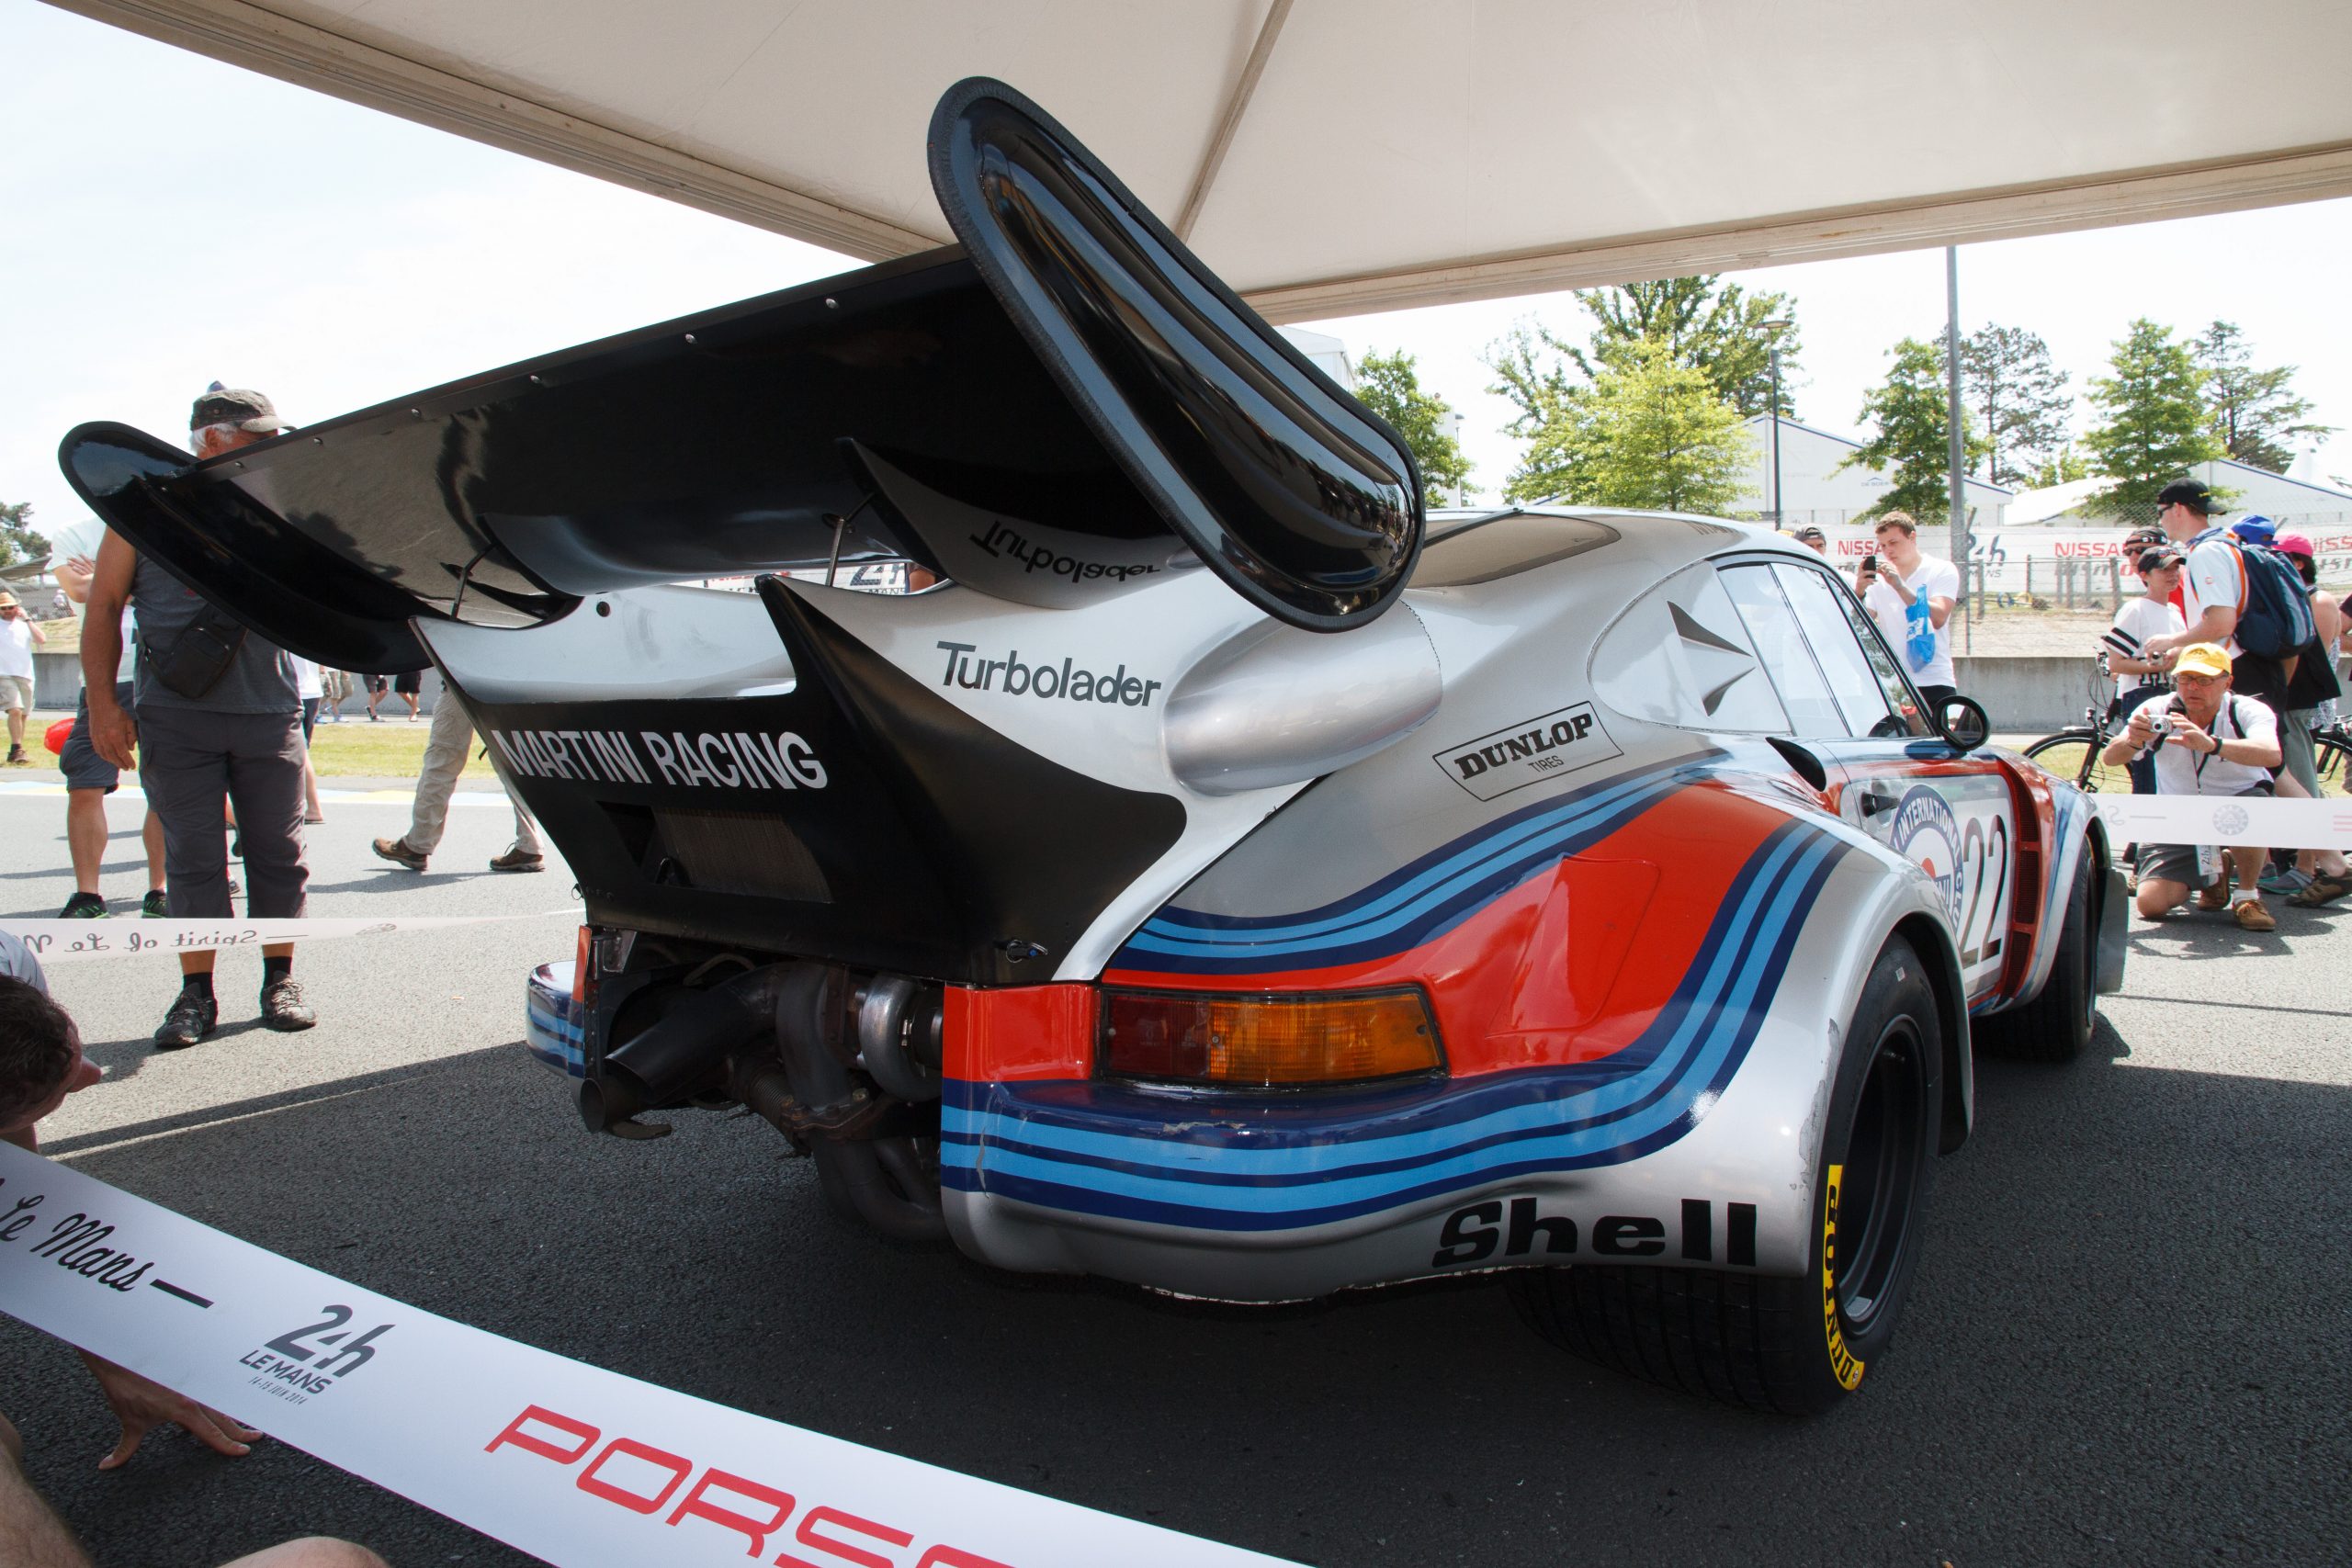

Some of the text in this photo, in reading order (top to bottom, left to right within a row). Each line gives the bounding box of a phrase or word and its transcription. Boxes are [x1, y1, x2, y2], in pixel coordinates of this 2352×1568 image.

[1838, 540, 1883, 556] NISSA
[2054, 543, 2127, 557] NISSA
[936, 640, 1161, 707] Turbolader
[491, 729, 828, 789] MARTINI RACING
[1453, 713, 1593, 780] DUNLOP
[1528, 755, 1565, 773] TIRES
[1897, 796, 1961, 867] INTERNATIONAL
[1951, 871, 1963, 929] CLU
[1961, 814, 2007, 970] 22
[29, 1213, 154, 1292] Mans
[1431, 1197, 1757, 1268] Shell
[239, 1349, 333, 1394] LE MANS
[264, 1304, 396, 1378] 24h
[248, 1376, 309, 1405] 14-15 JUIN 2014
[483, 1404, 1018, 1568] PORS
